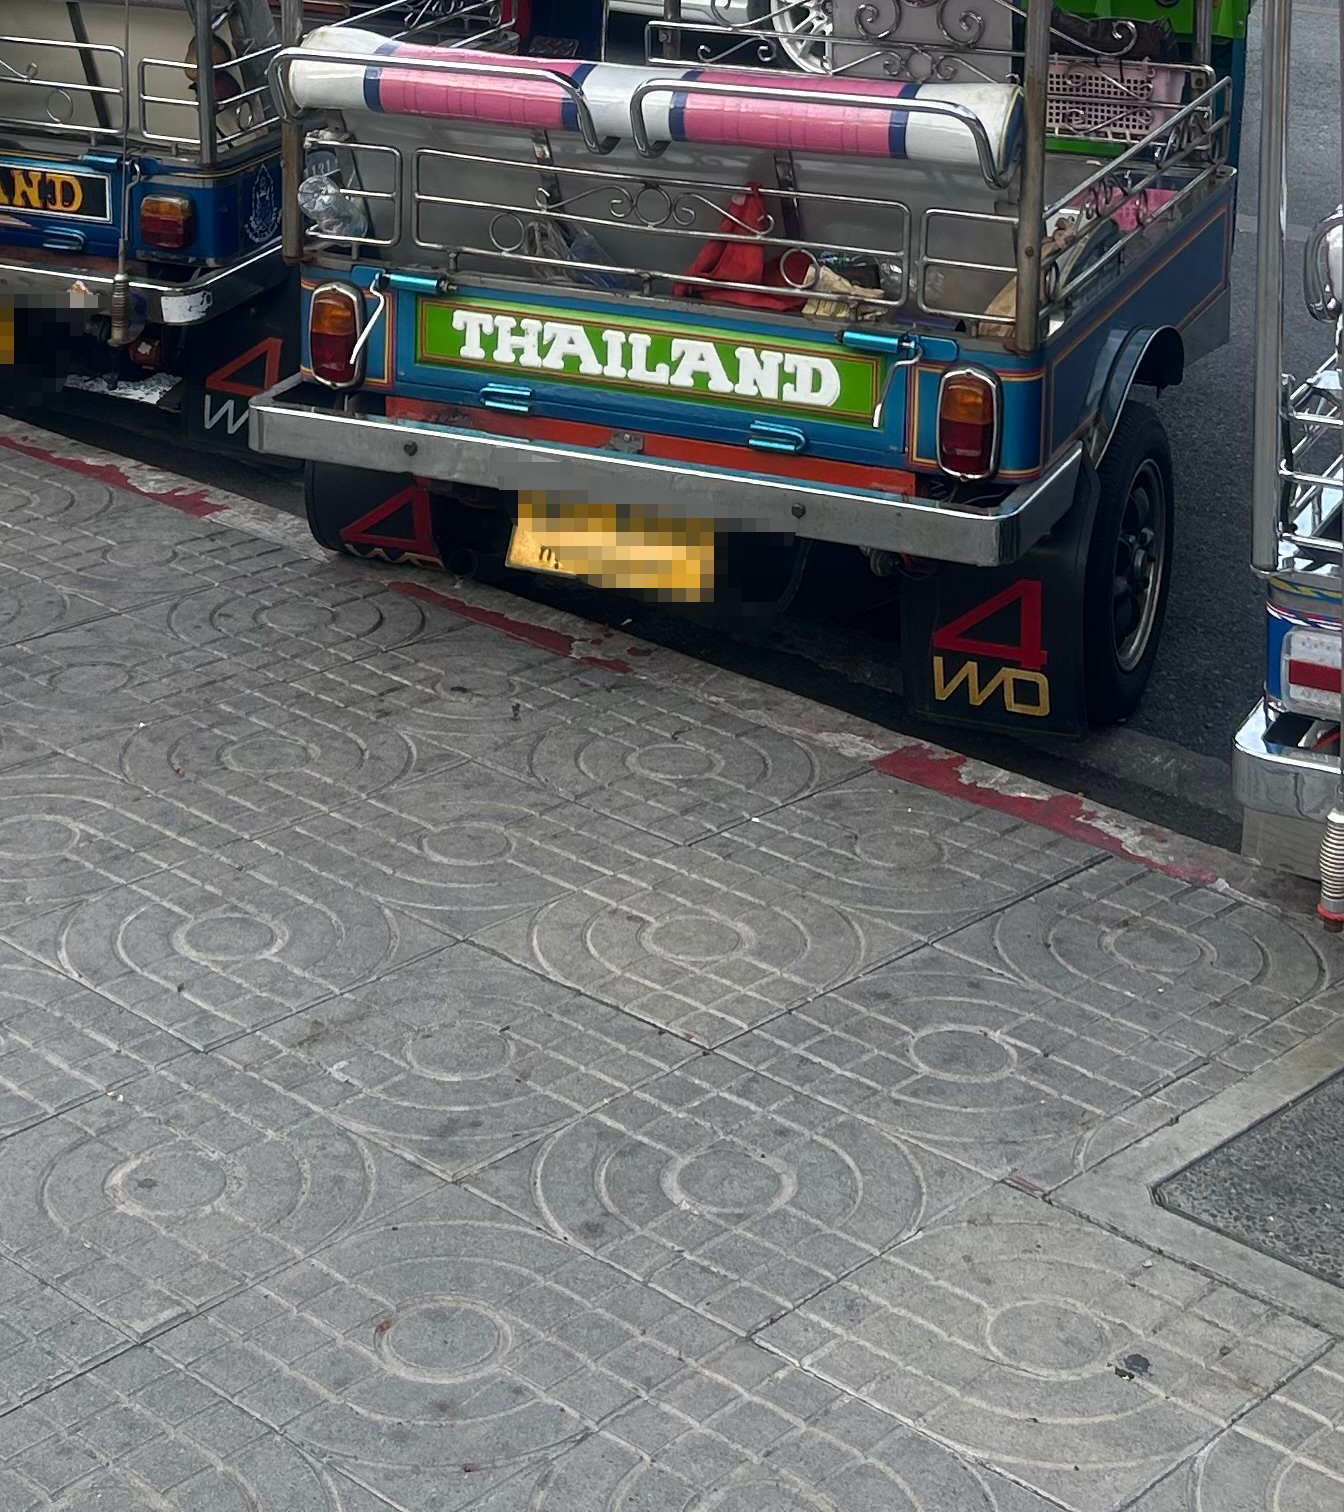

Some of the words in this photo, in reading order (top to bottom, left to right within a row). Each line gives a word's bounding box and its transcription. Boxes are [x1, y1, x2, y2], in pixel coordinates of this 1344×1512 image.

[452, 309, 841, 407] THAILAND
[204, 394, 250, 435] W
[932, 578, 1048, 670] 4
[933, 656, 1050, 717] WD
